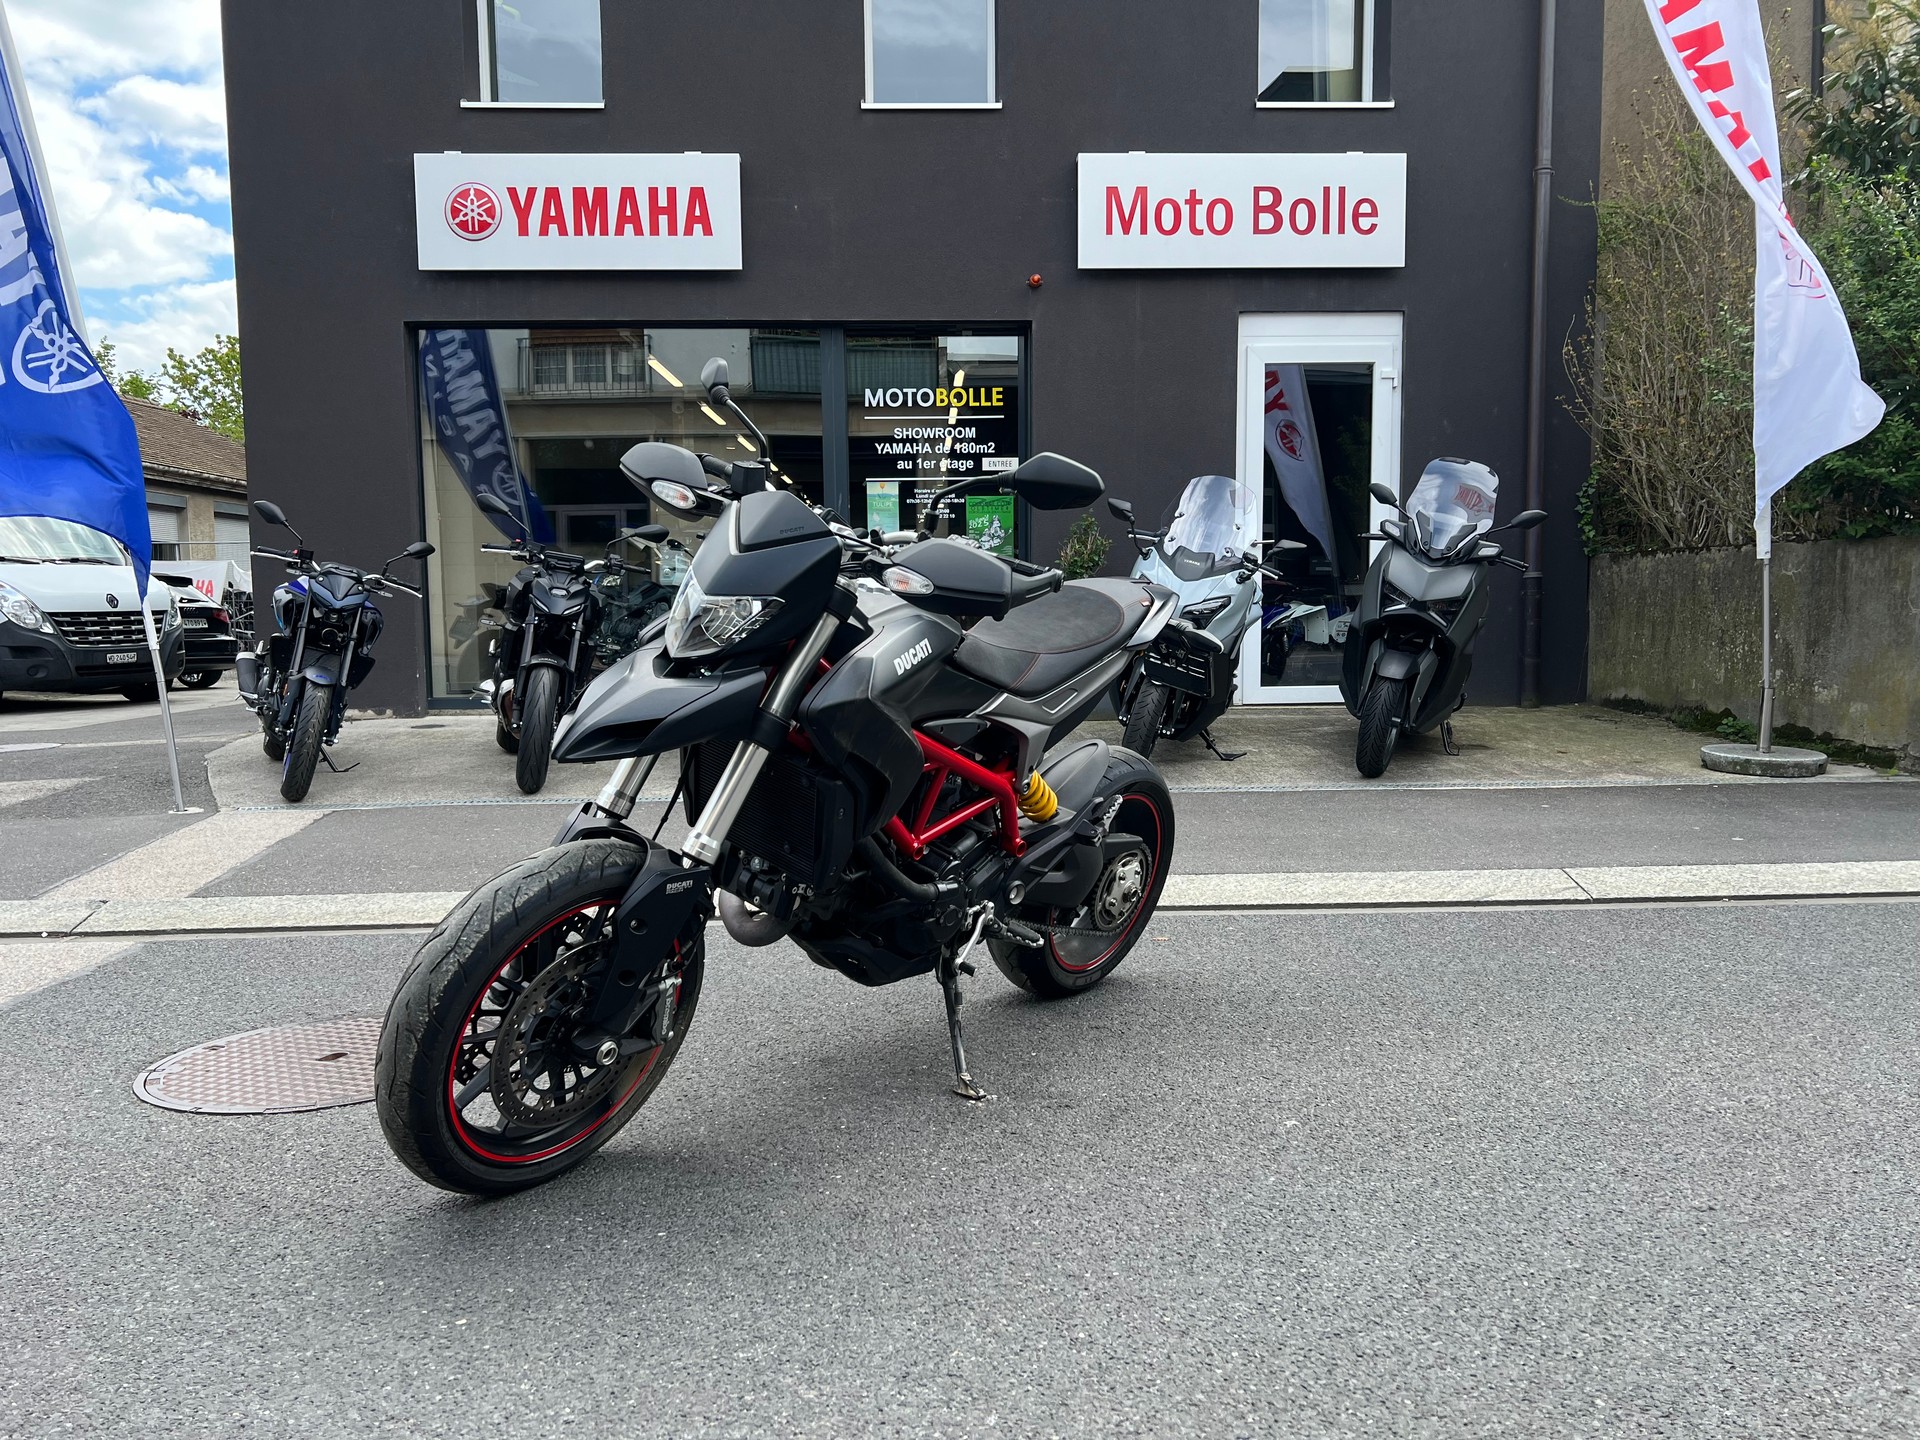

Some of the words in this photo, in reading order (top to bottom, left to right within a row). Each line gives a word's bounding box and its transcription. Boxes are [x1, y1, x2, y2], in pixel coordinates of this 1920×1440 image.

[505, 186, 714, 237] YAMAHA
[1105, 185, 1234, 236] Moto
[1252, 185, 1379, 236] Bolle
[864, 387, 1004, 408] MOTOBOLLE
[893, 427, 976, 439] SHOWROOM
[874, 443, 933, 455] YAMAHA
[935, 442, 951, 454] de
[896, 460, 913, 470] au
[917, 458, 937, 469] 1er
[939, 458, 974, 472] étage
[892, 637, 933, 676] DUCATI
[666, 879, 693, 889] DUCATI
